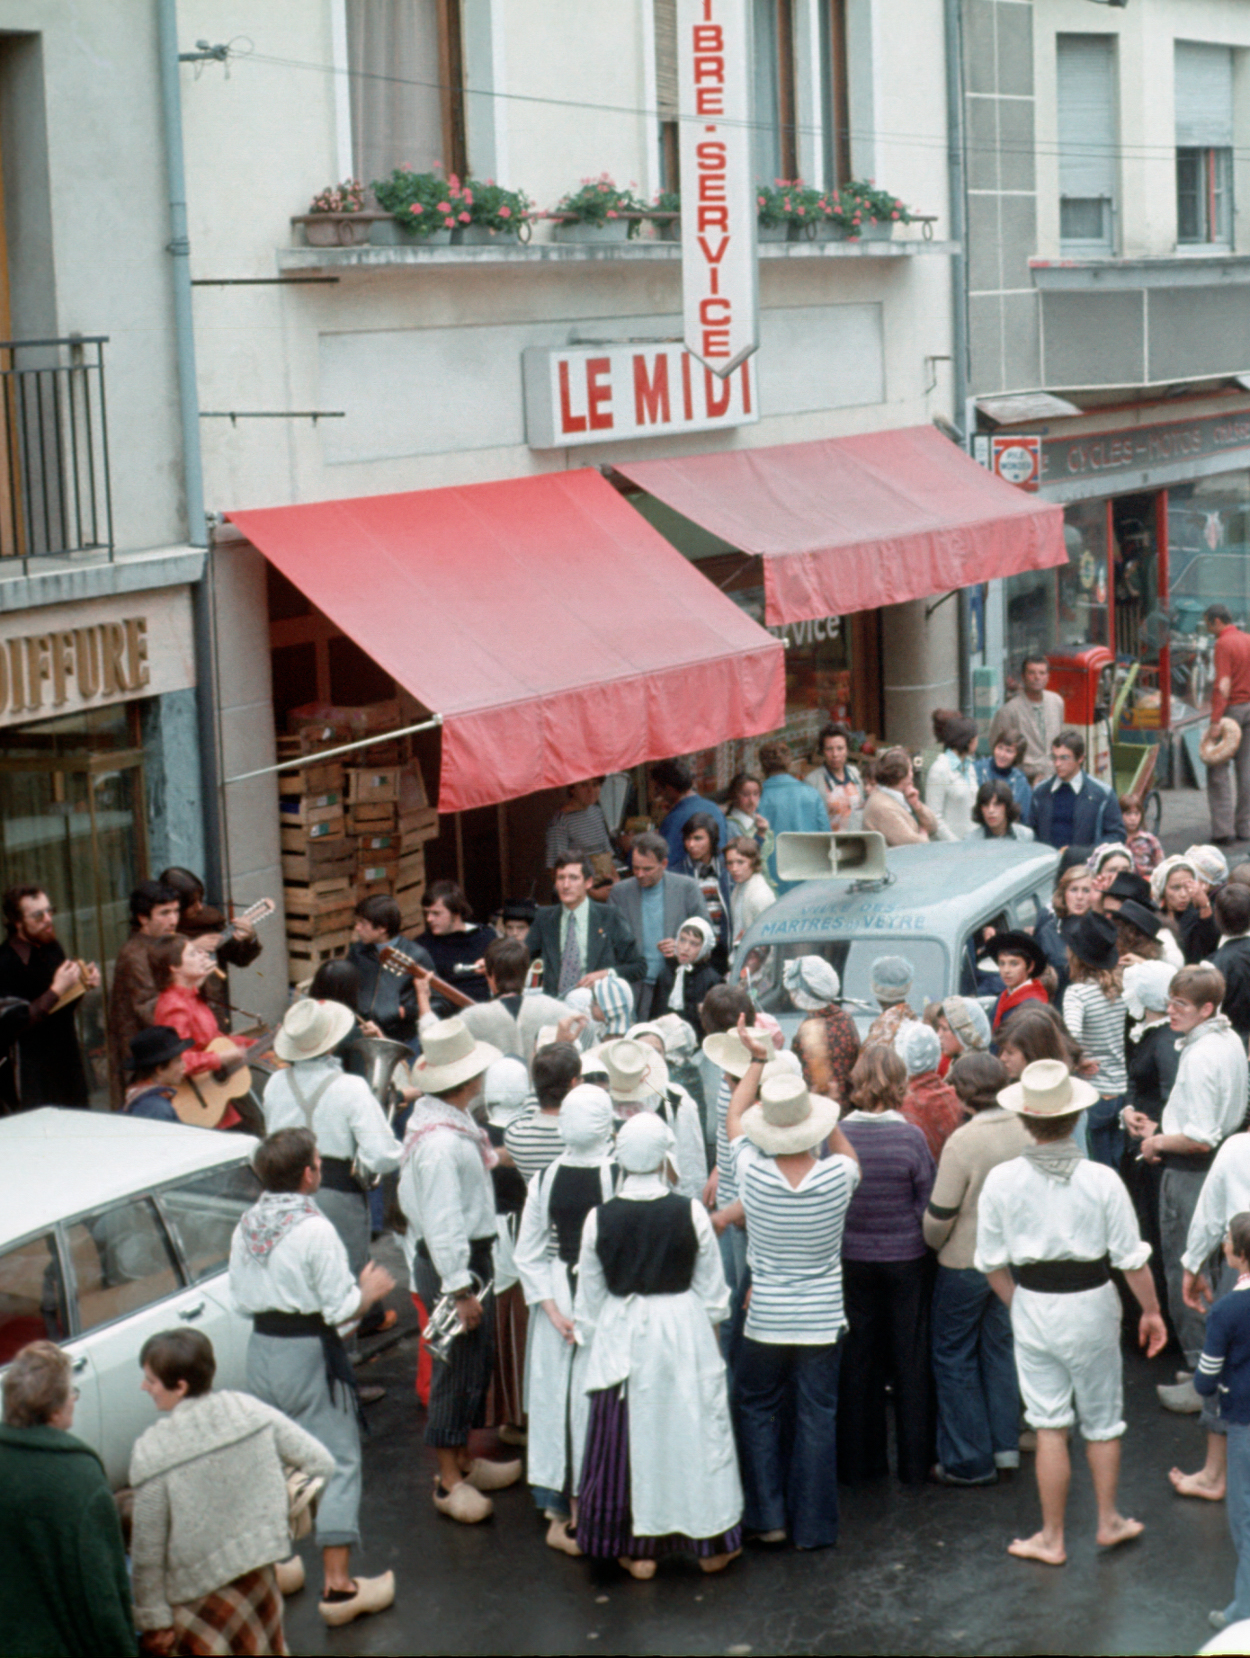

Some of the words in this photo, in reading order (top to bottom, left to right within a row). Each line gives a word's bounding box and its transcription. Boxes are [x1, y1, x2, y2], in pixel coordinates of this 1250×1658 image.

[558, 357, 614, 434] LE
[633, 351, 751, 426] MIDI
[801, 901, 850, 915] VILLE
[859, 900, 899, 914] DES
[761, 915, 844, 937] MARTRES
[863, 914, 926, 930] VEYRE
